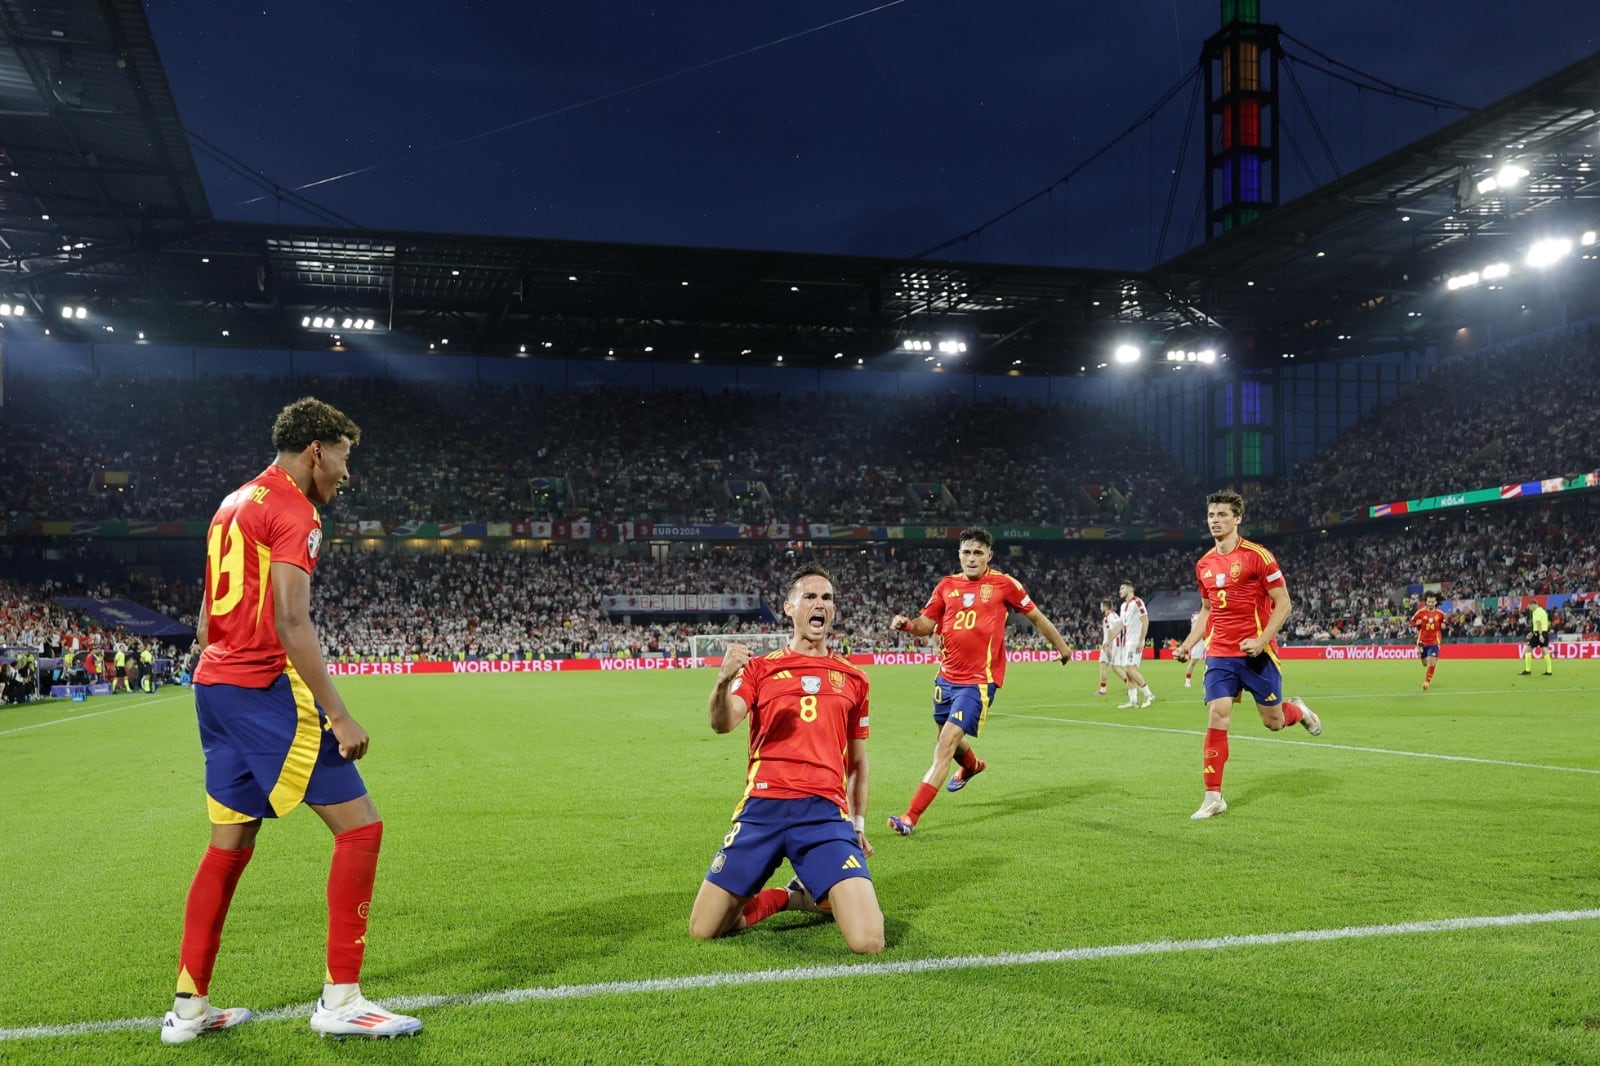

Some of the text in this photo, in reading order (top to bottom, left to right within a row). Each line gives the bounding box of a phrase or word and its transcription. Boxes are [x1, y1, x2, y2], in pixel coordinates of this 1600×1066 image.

[1003, 529, 1029, 537] KÖLN
[640, 596, 719, 609] BELIEVE
[1217, 590, 1227, 608] 3
[953, 610, 977, 630] 20
[1325, 647, 1419, 658] One World Account
[326, 662, 414, 676] RLDFIRST
[452, 659, 564, 673] WORLDFIRST
[800, 695, 817, 723] 8
[724, 821, 741, 847] 8
